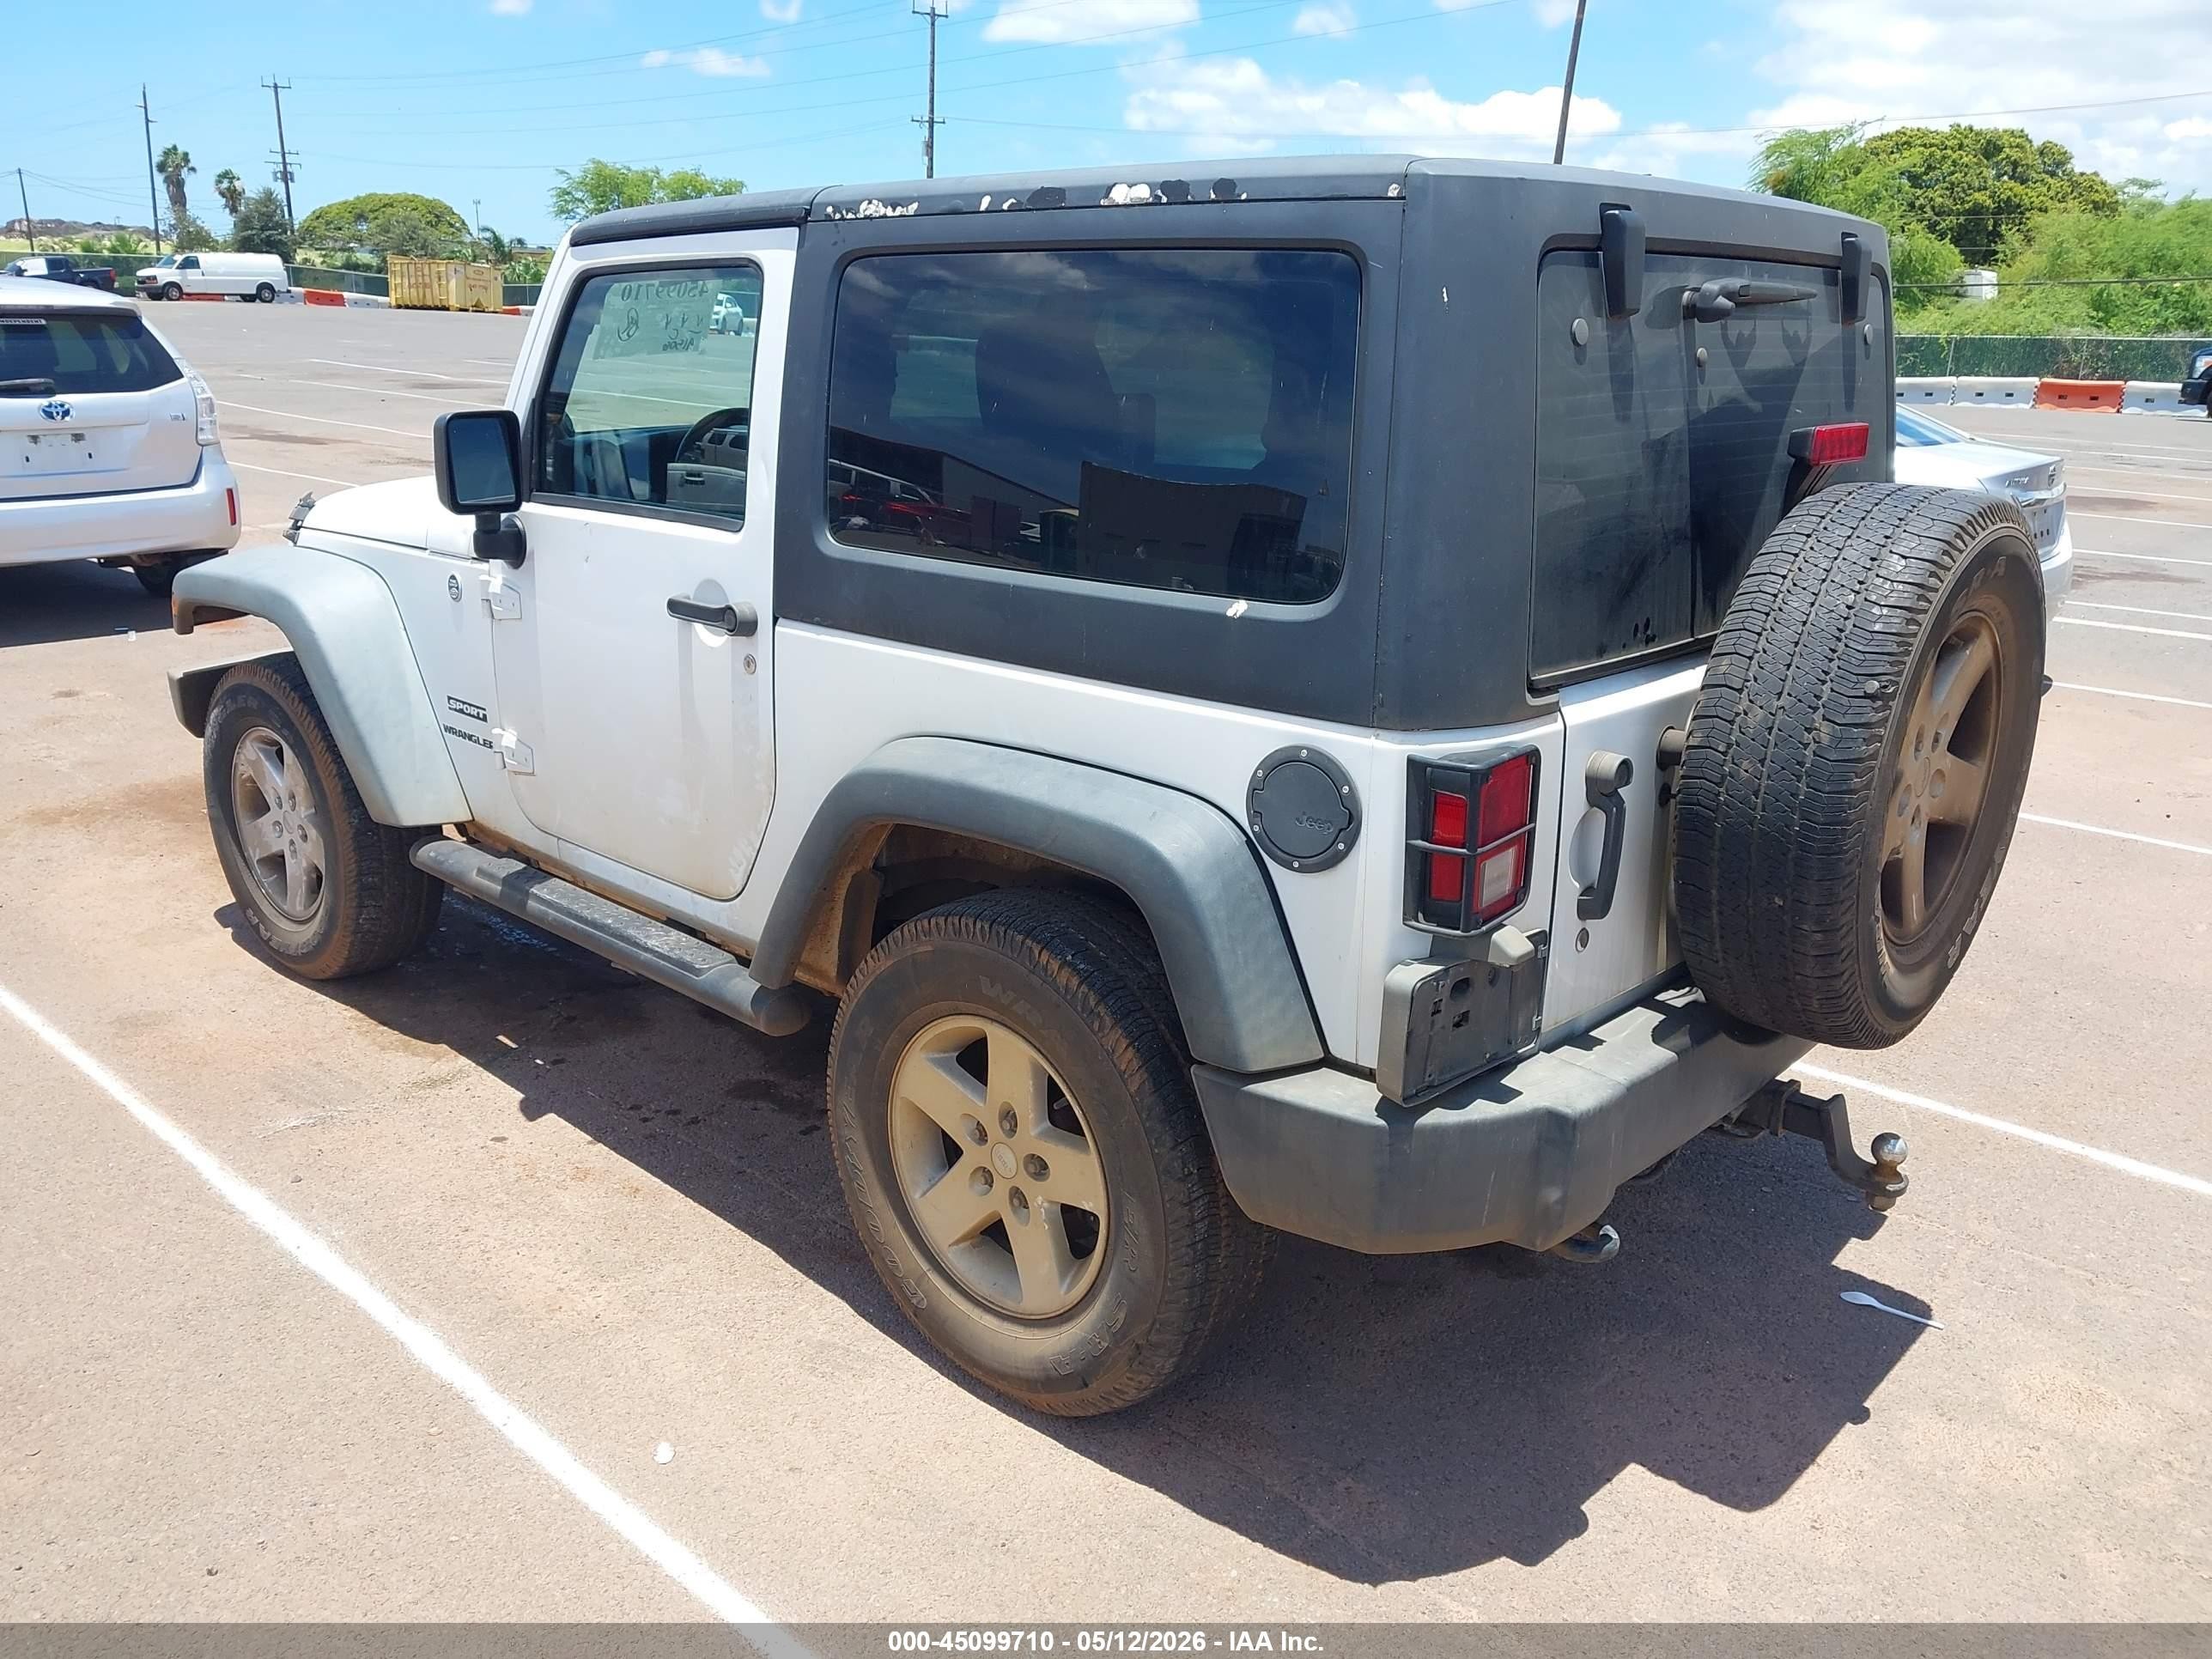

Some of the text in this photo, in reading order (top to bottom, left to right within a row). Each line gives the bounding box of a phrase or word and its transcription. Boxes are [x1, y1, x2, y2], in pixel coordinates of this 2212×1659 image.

[448, 698, 484, 719] SPORT
[442, 723, 494, 750] WRANGLER
[1295, 811, 1334, 836] Jeep
